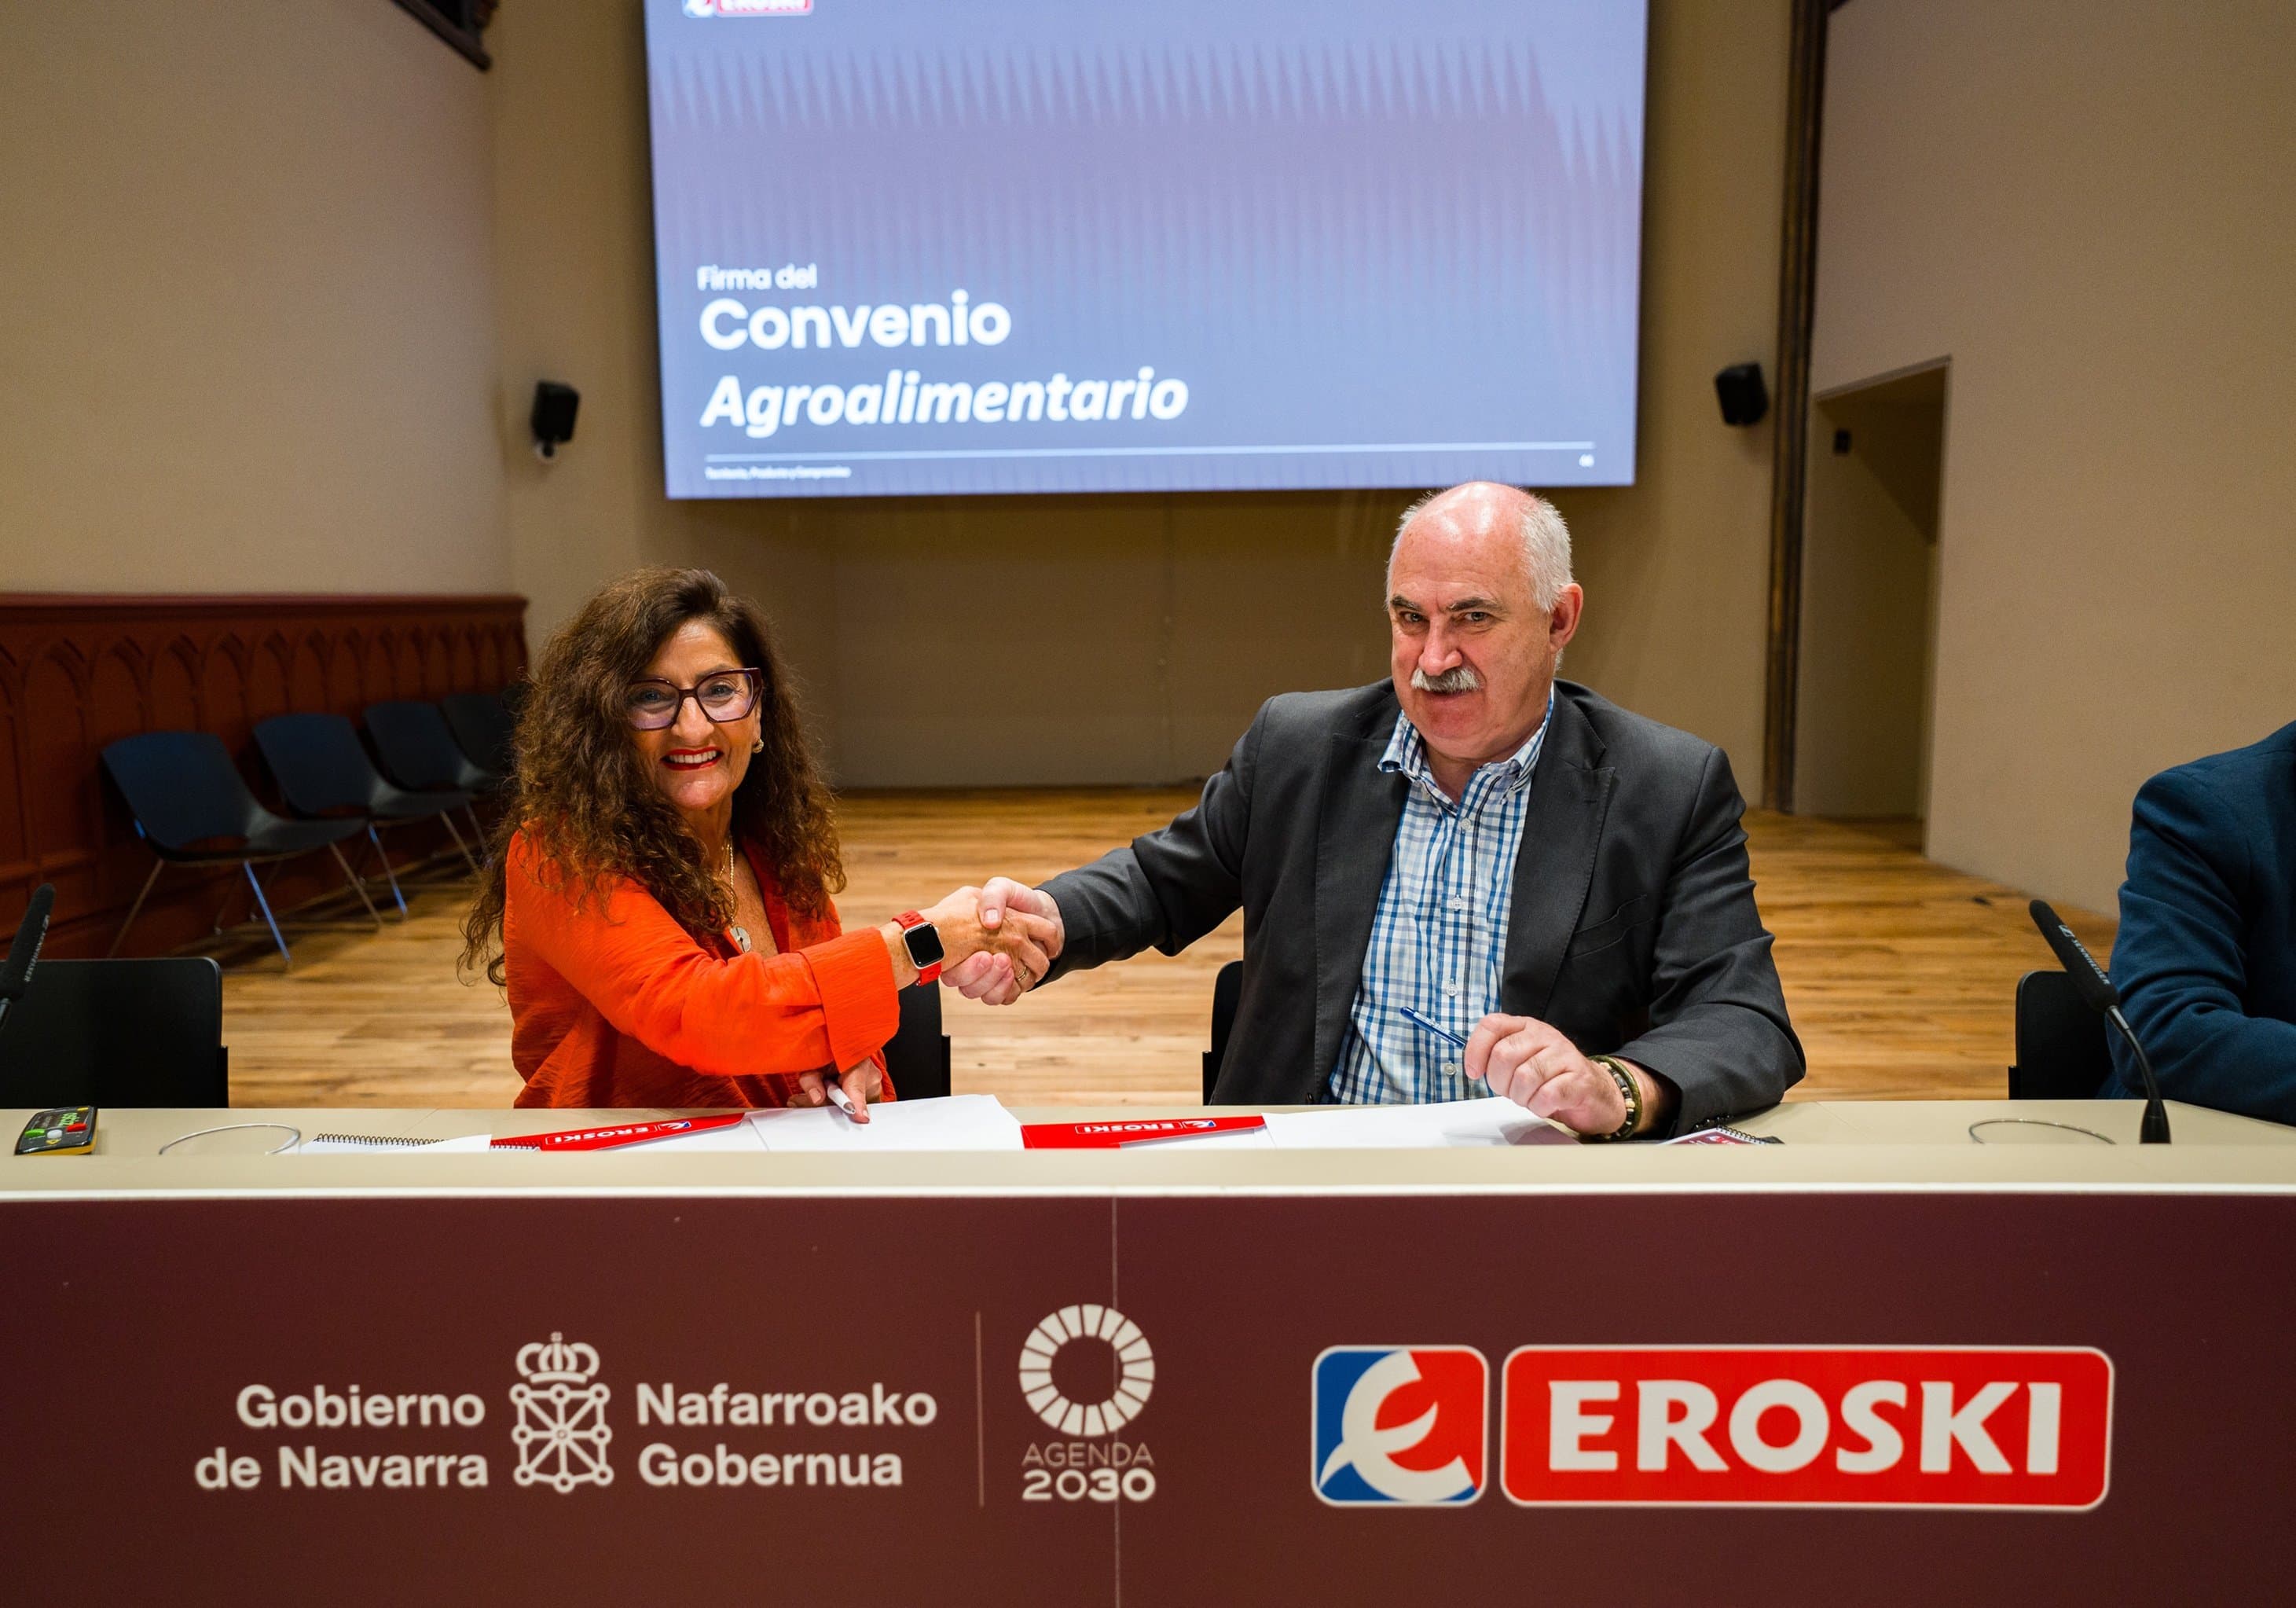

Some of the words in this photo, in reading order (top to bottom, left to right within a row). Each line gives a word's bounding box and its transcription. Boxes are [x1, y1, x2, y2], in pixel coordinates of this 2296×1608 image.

[697, 265, 772, 291] Firma
[775, 263, 817, 289] del
[699, 288, 1011, 351] Convenio
[699, 366, 1189, 438] Agroalimentario
[555, 1127, 648, 1143] EROSKI
[1084, 1123, 1175, 1133] EROSKI
[236, 1384, 486, 1427] Gobierno
[636, 1382, 937, 1426] Nafarroako
[1549, 1379, 2062, 1474] EROSKI
[195, 1446, 262, 1489] de
[278, 1445, 489, 1488] Navarra
[638, 1442, 903, 1486] Gobernua
[1022, 1442, 1155, 1467] AGENDA
[1022, 1467, 1156, 1502] 2030
